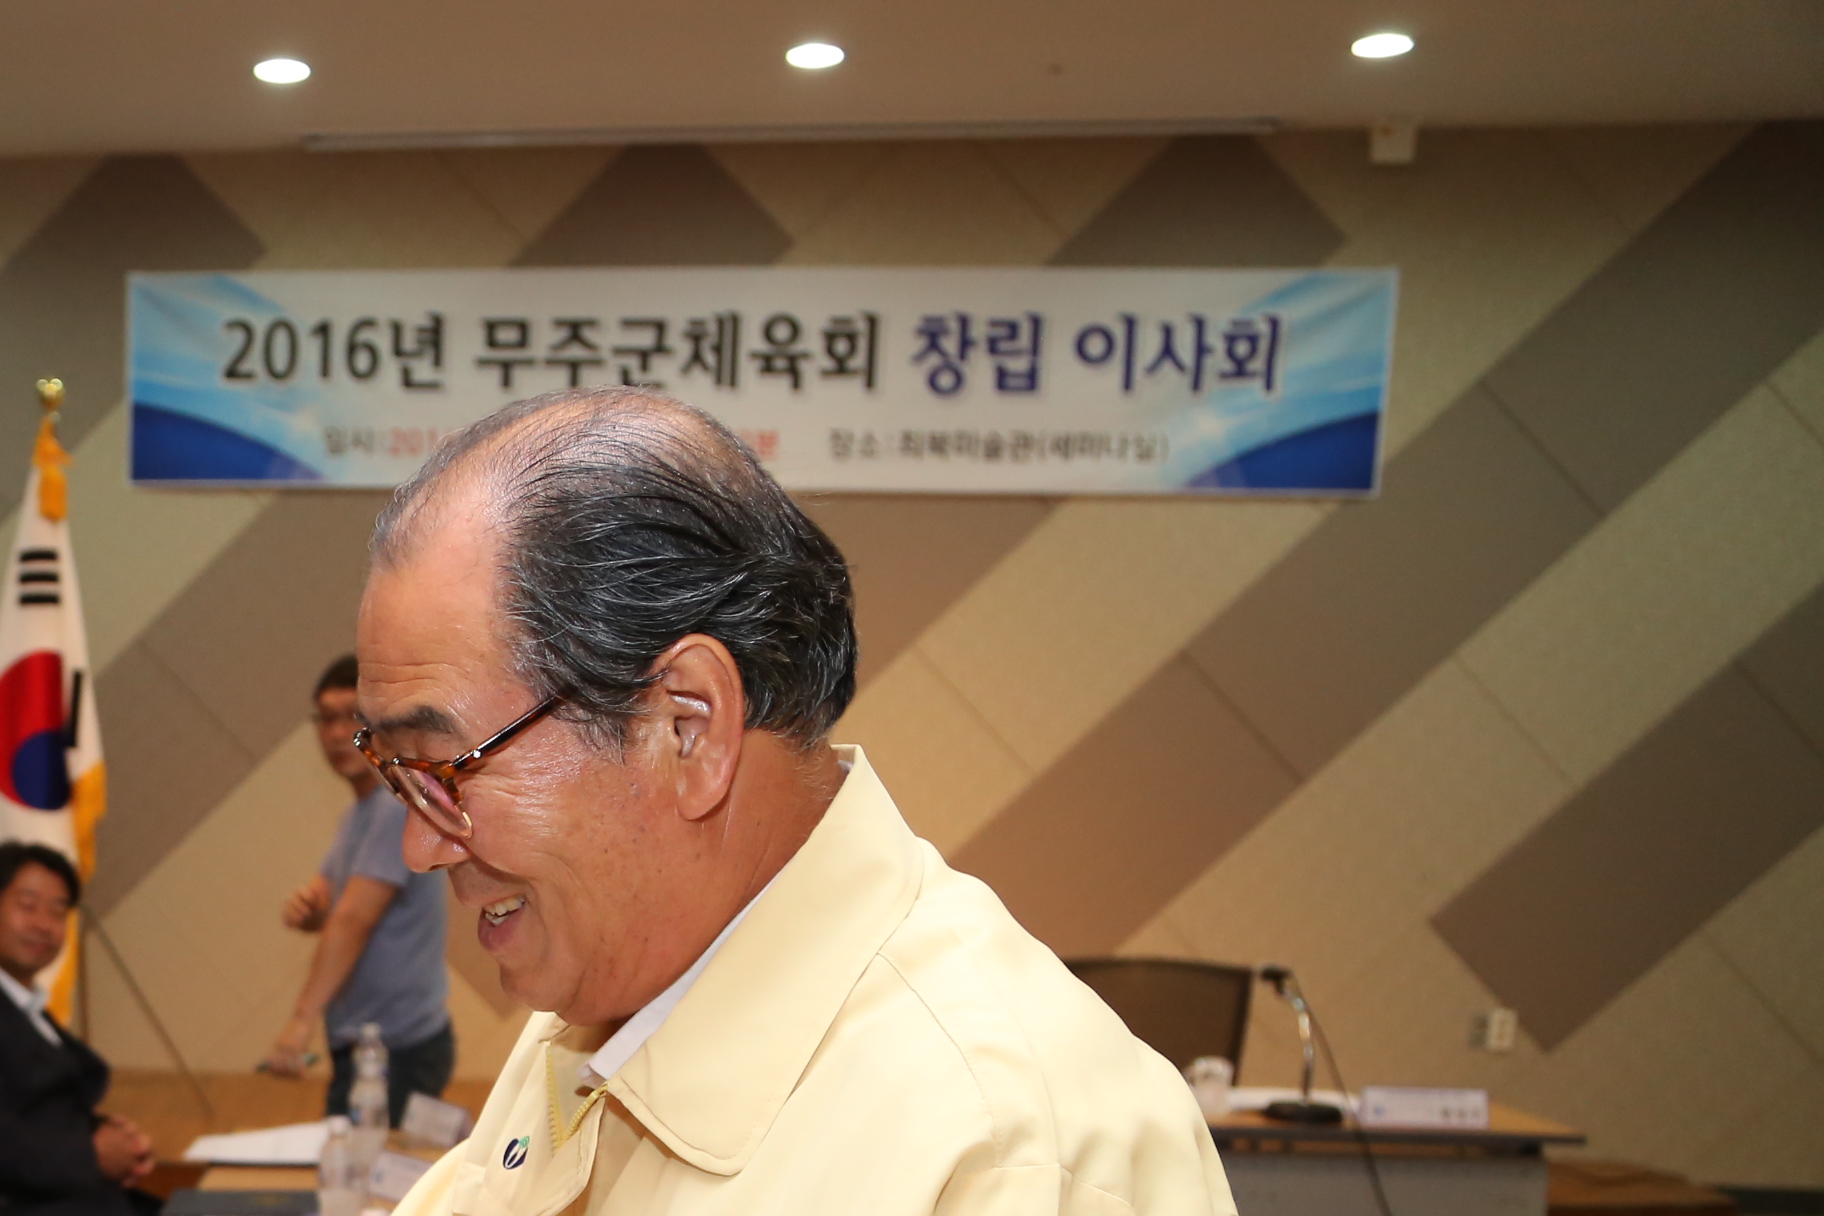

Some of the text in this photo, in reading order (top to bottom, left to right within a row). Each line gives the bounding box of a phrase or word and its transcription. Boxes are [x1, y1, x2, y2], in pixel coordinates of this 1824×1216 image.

[222, 312, 1278, 396] 2016년 무주군체육회 창립 이사회
